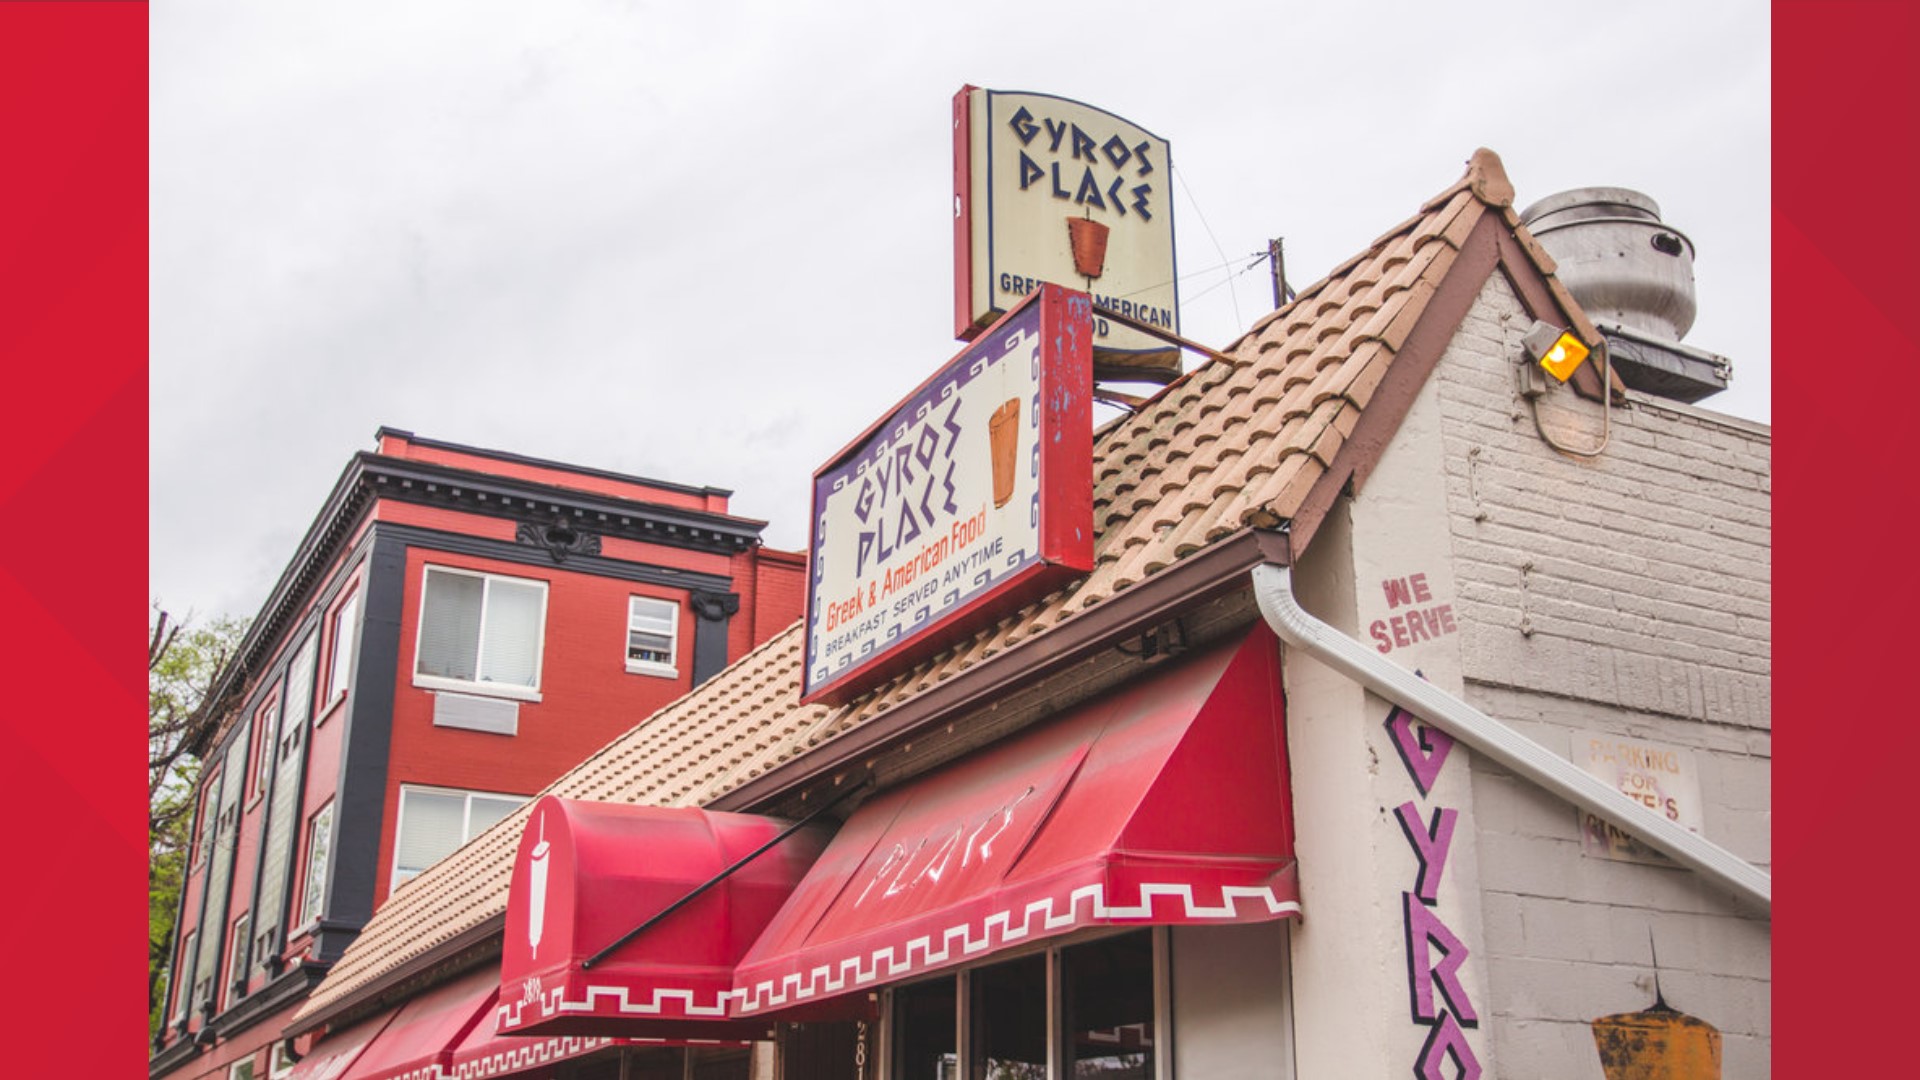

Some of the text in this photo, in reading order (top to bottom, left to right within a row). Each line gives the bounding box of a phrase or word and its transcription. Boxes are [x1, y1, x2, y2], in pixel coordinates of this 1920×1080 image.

[1009, 106, 1154, 177] GYROS
[1020, 150, 1153, 222] PLACE
[1095, 294, 1172, 328] MERICAN
[854, 397, 962, 523] GYROS
[856, 459, 958, 578] PLACE
[825, 536, 1003, 657] BREAKFAST SERVED ANYTIME
[827, 502, 987, 632] Greek & American Food
[1382, 572, 1432, 609] WE
[1369, 604, 1457, 653] SERVE
[1589, 739, 1680, 775] PARKING
[1620, 772, 1658, 791] FOR
[1383, 668, 1482, 1080] GYRO
